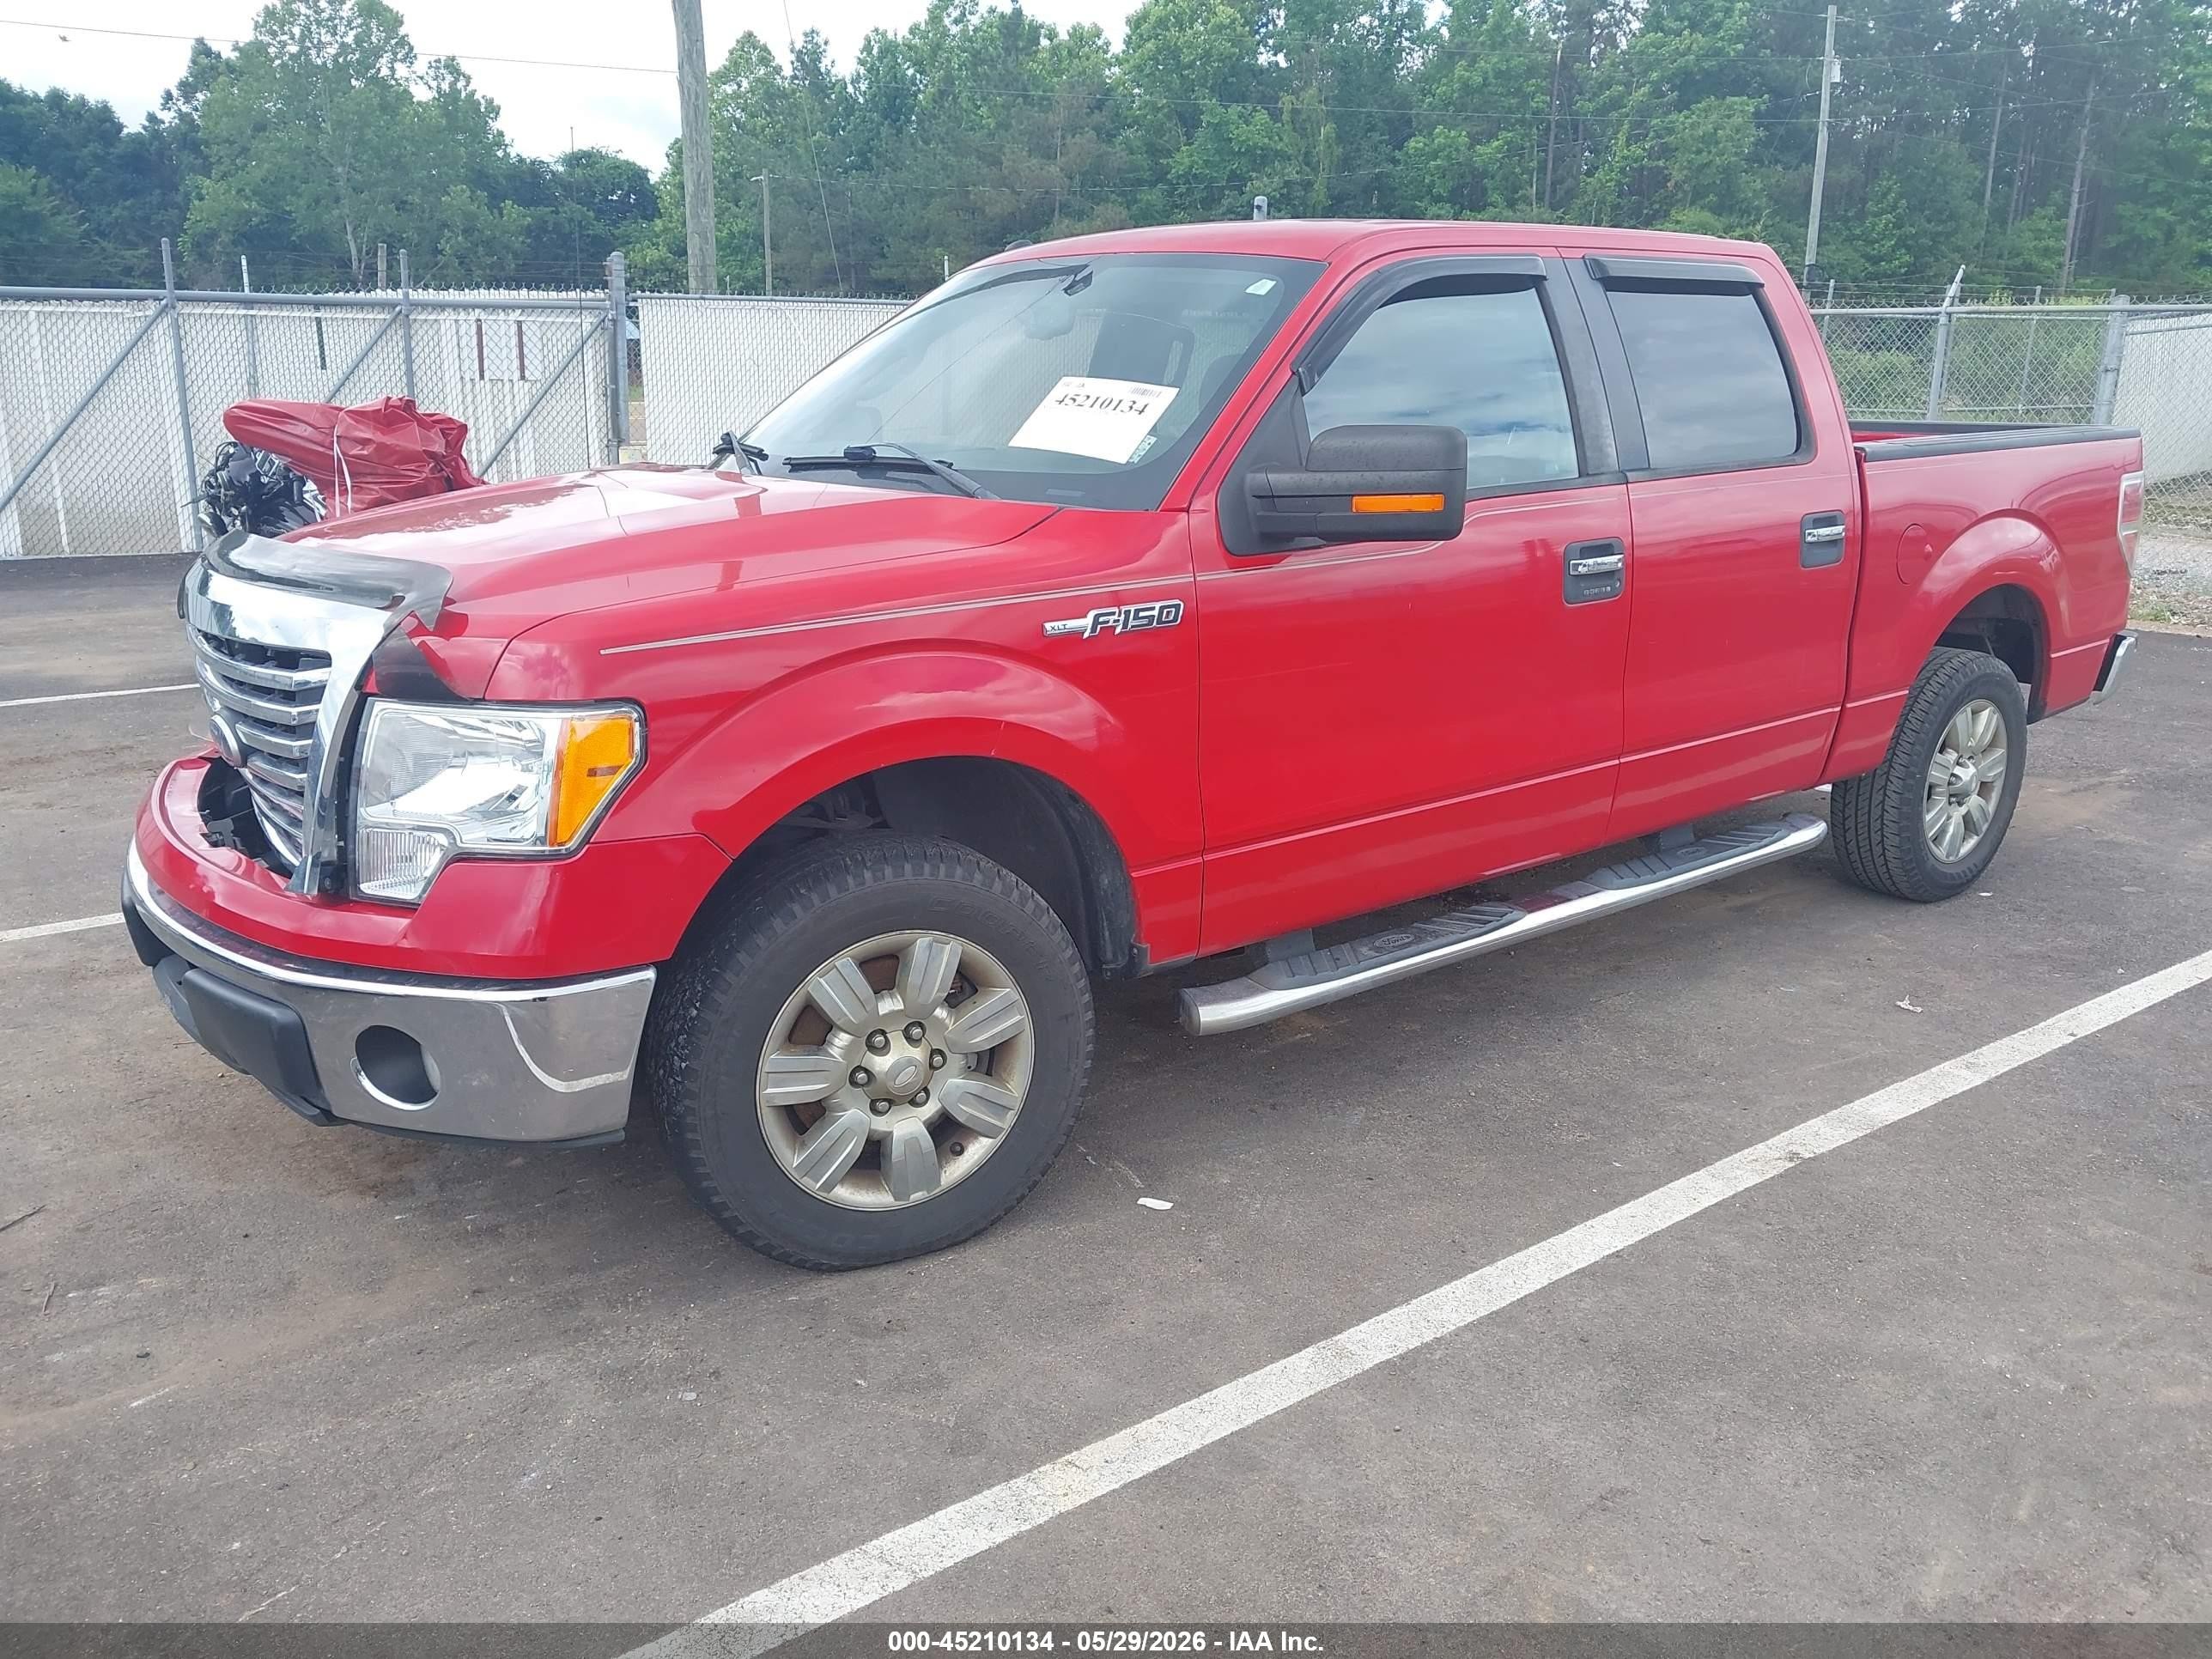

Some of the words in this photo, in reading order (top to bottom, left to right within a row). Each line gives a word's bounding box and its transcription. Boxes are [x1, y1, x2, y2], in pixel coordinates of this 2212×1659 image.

[1055, 393, 1149, 416] 45210134
[1049, 623, 1068, 632] XLT
[1084, 600, 1184, 638] F-150
